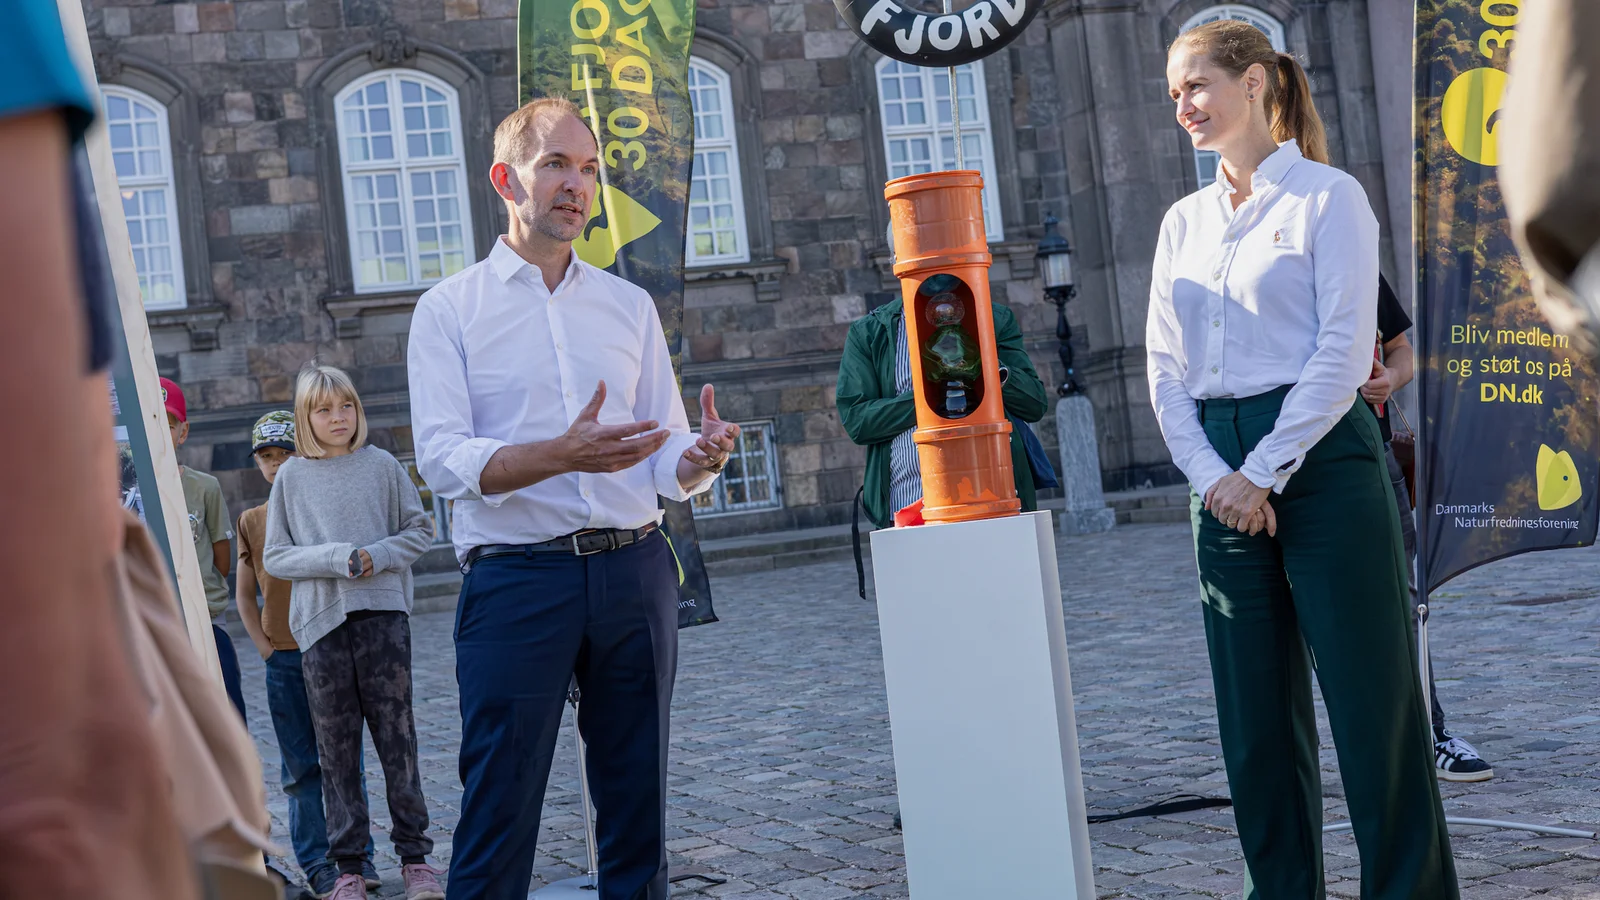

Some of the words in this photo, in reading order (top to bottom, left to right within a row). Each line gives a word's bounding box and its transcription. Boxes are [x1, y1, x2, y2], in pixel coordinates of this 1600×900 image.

[1479, 0, 1523, 60] 30
[605, 106, 649, 171] 30
[1451, 324, 1490, 344] Bliv
[1496, 326, 1569, 348] medlem
[1447, 357, 1473, 377] og
[1480, 354, 1521, 374] støt
[1525, 359, 1544, 375] os
[1548, 357, 1572, 380] på
[1480, 382, 1544, 405] DN.dk
[1435, 502, 1495, 515] Danmarks
[1454, 516, 1580, 530] Naturfredningsforening
